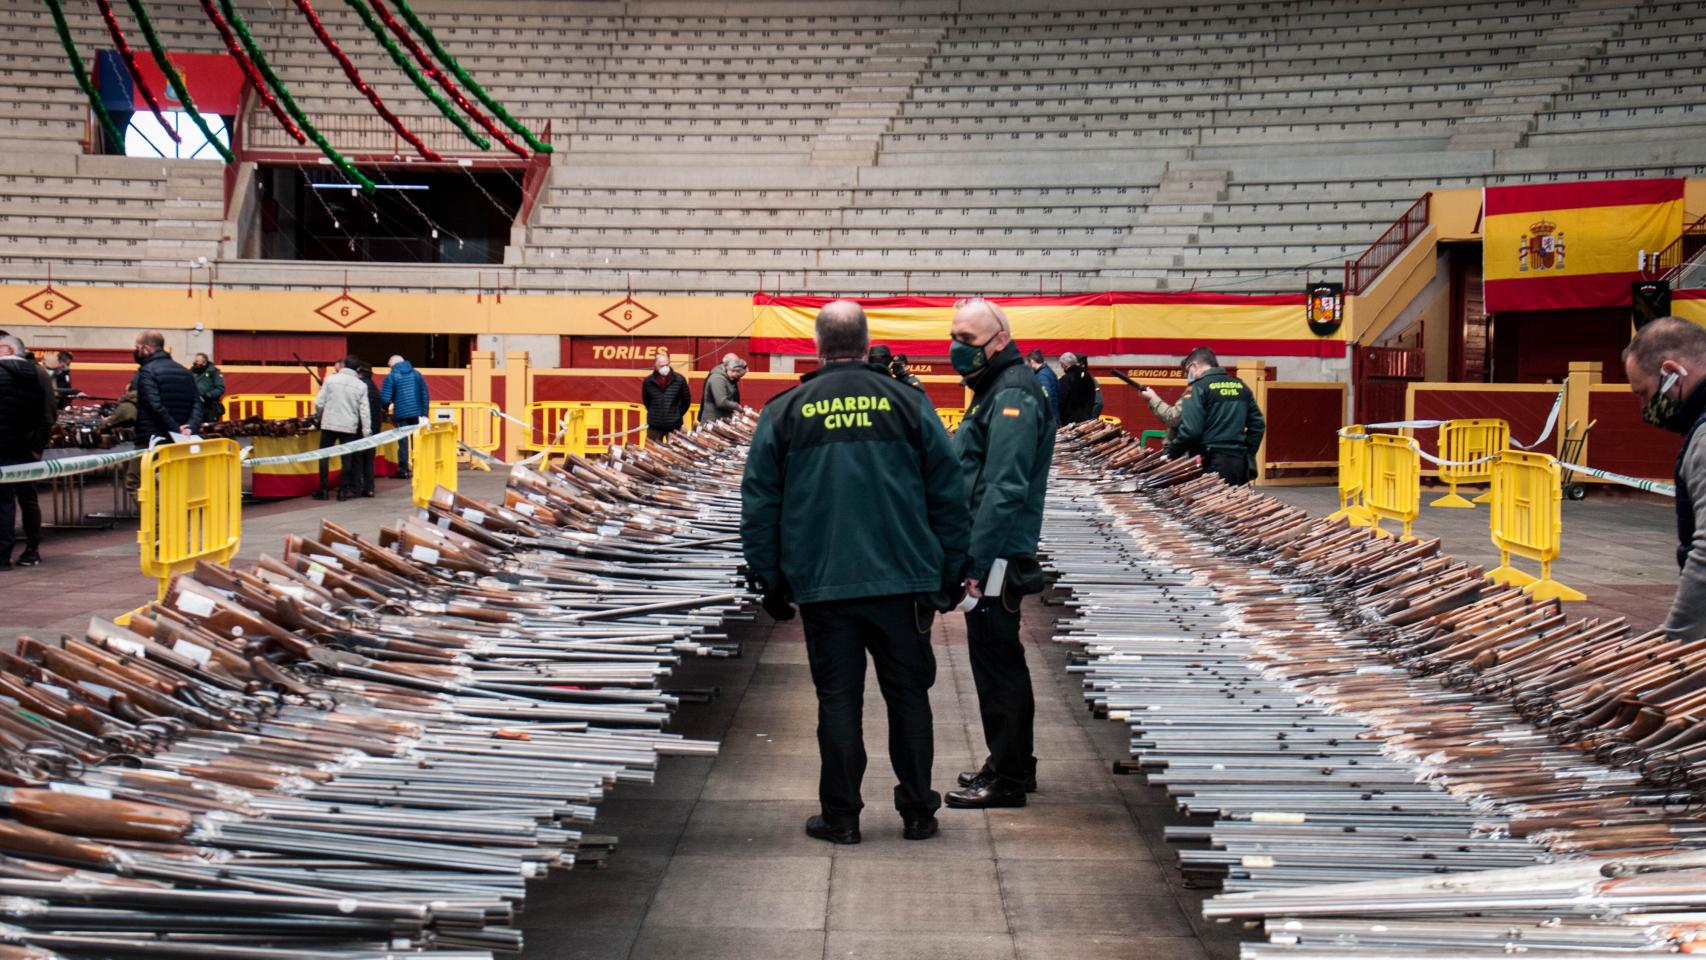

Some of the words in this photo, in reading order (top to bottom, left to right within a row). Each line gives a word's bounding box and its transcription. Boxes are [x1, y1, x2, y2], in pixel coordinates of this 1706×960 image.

[43, 299, 54, 311] 6
[340, 306, 351, 317] 6
[623, 310, 634, 321] 6
[592, 345, 668, 360] TORILES
[1127, 369, 1168, 378] SERVICIO
[1169, 369, 1182, 378] DE
[801, 395, 892, 418] GUARDIA
[825, 411, 873, 430] CIVIL
